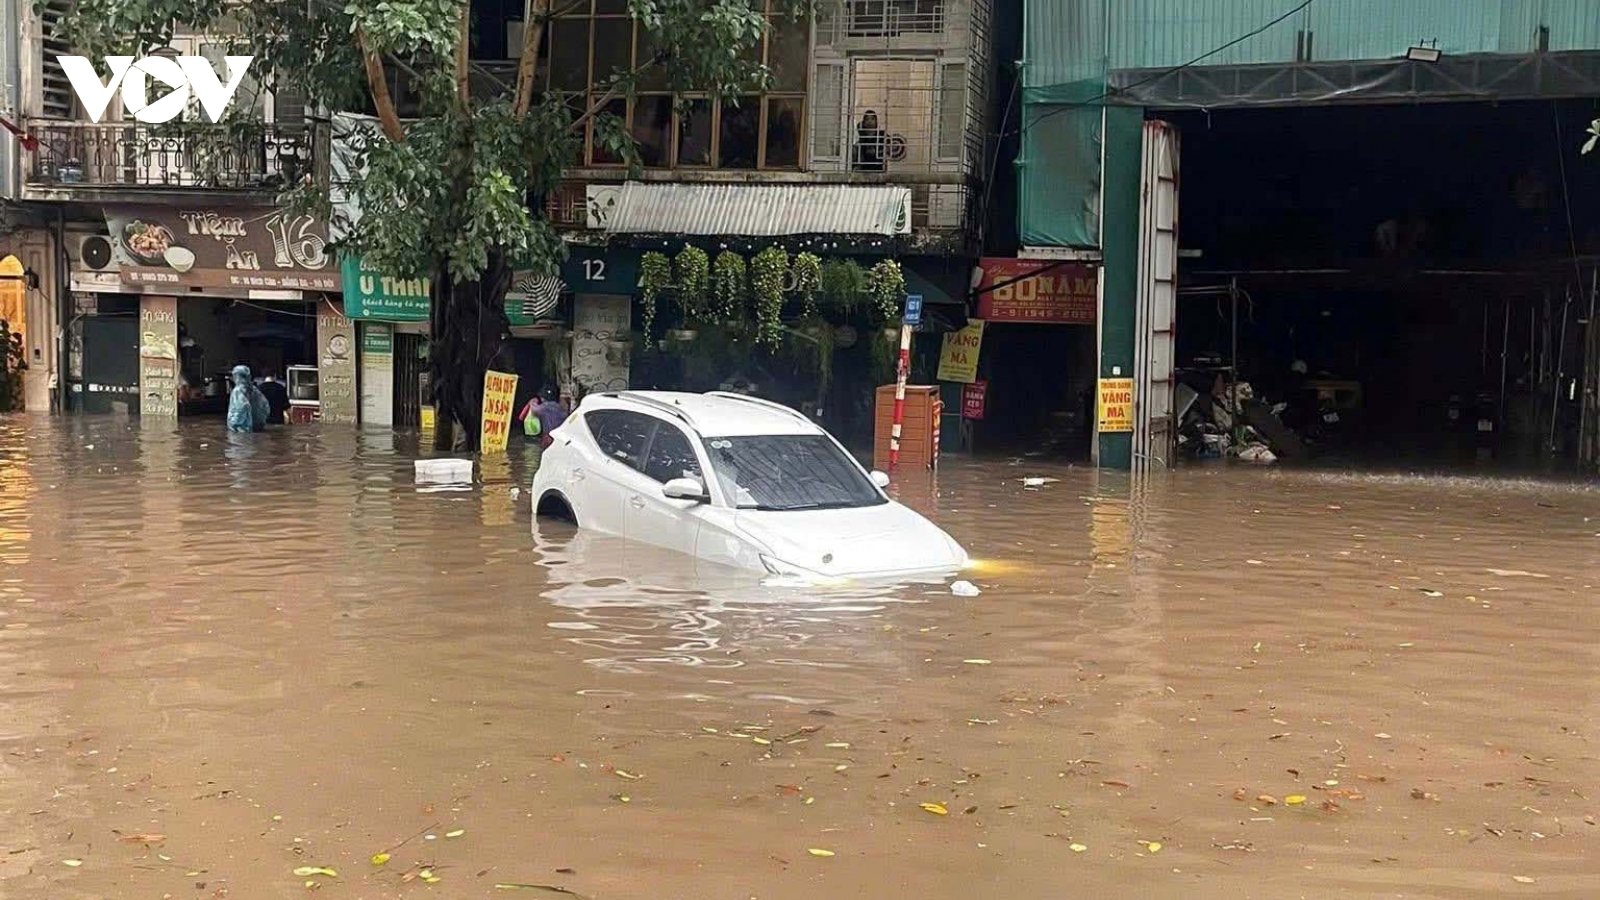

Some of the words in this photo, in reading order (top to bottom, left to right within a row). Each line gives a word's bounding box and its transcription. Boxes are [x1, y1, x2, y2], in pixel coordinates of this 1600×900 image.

[179, 210, 247, 241] Tiệm
[225, 237, 260, 270] Ăn
[265, 213, 329, 270] 16
[582, 259, 605, 281] 12
[1101, 390, 1131, 404] VÀNG
[1106, 405, 1125, 418] MÃ
